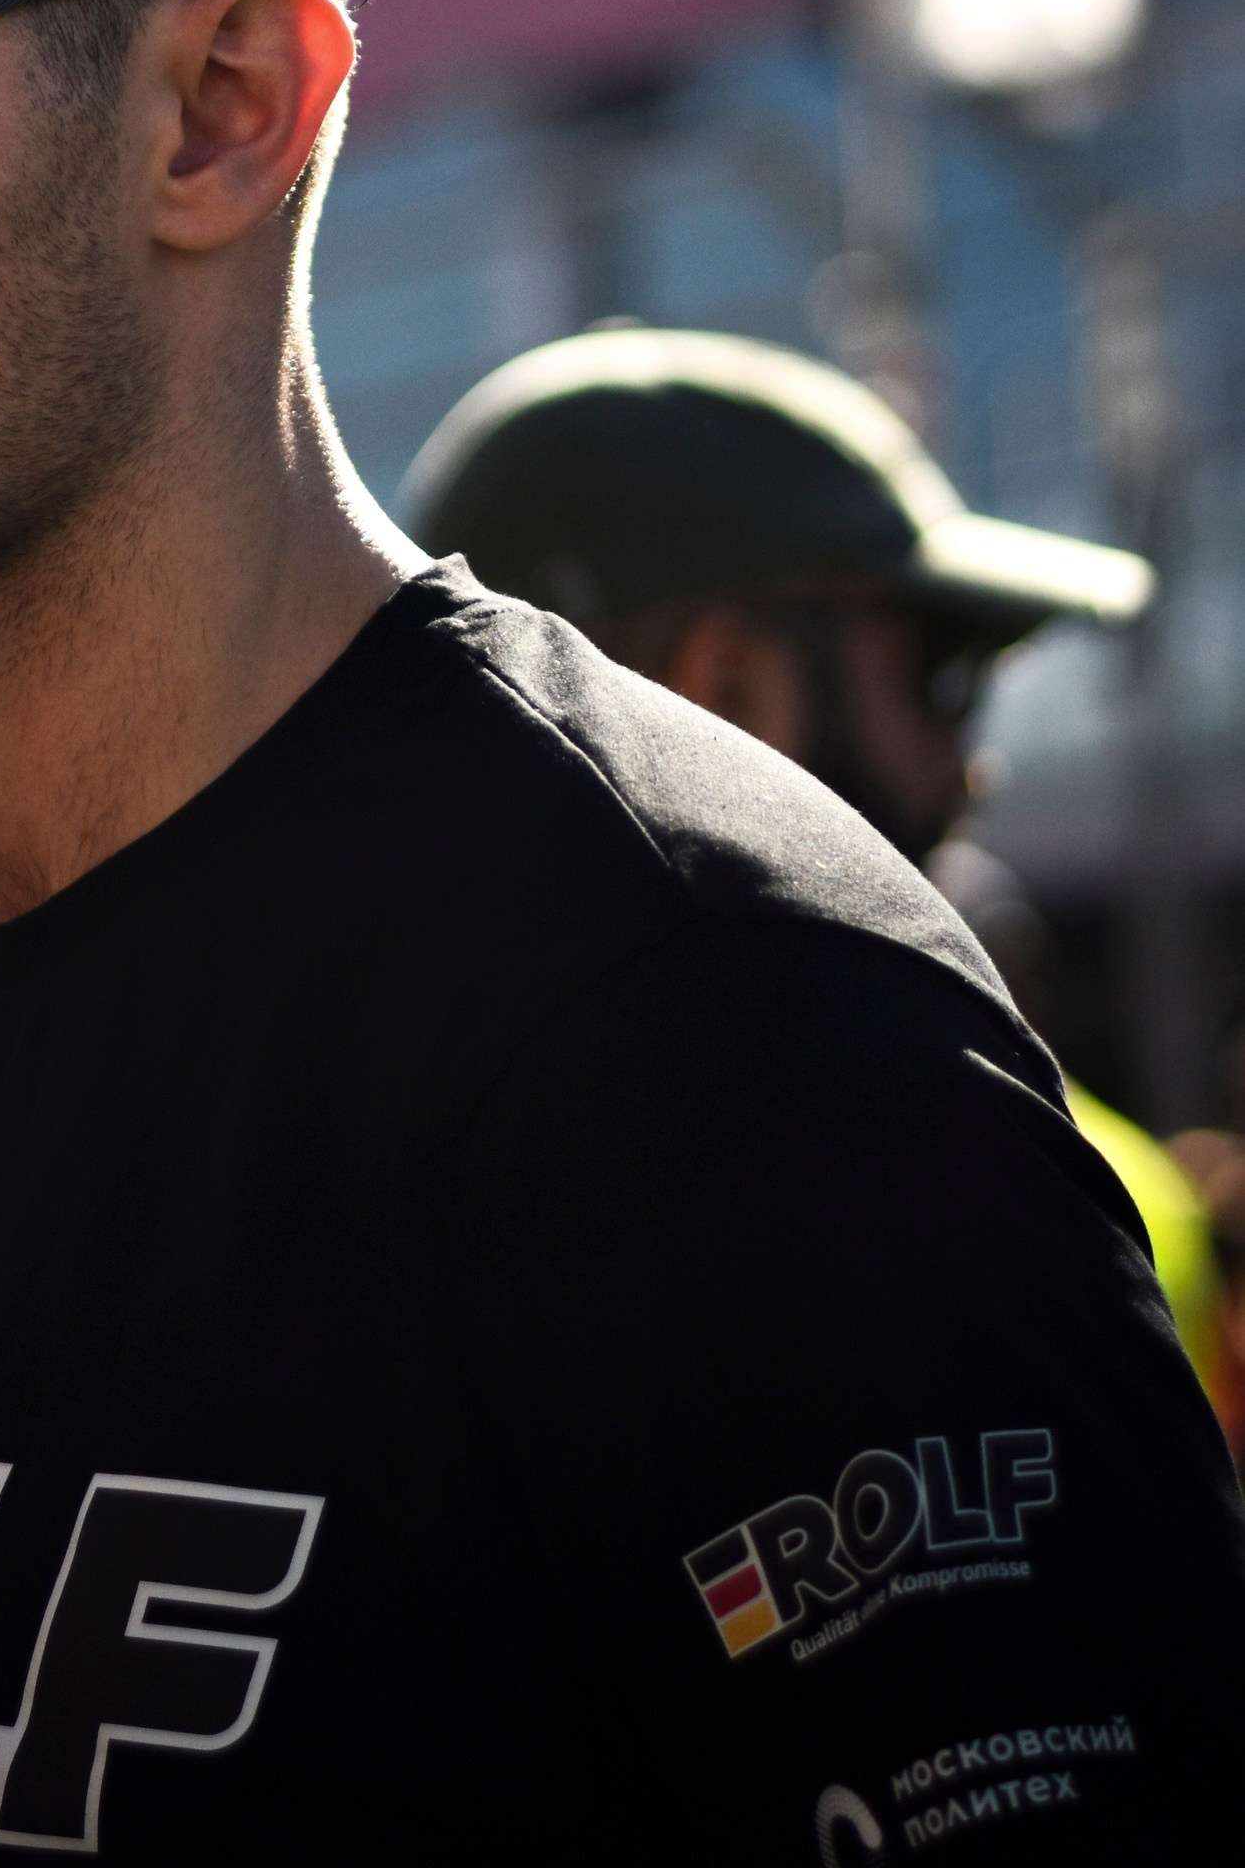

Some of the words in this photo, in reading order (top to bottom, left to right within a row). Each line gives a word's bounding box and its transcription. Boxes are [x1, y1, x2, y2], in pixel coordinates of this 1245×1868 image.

[745, 1428, 1057, 1628] ROLF
[789, 1608, 861, 1661] Qualität
[889, 1559, 1031, 1598] Kompromisse
